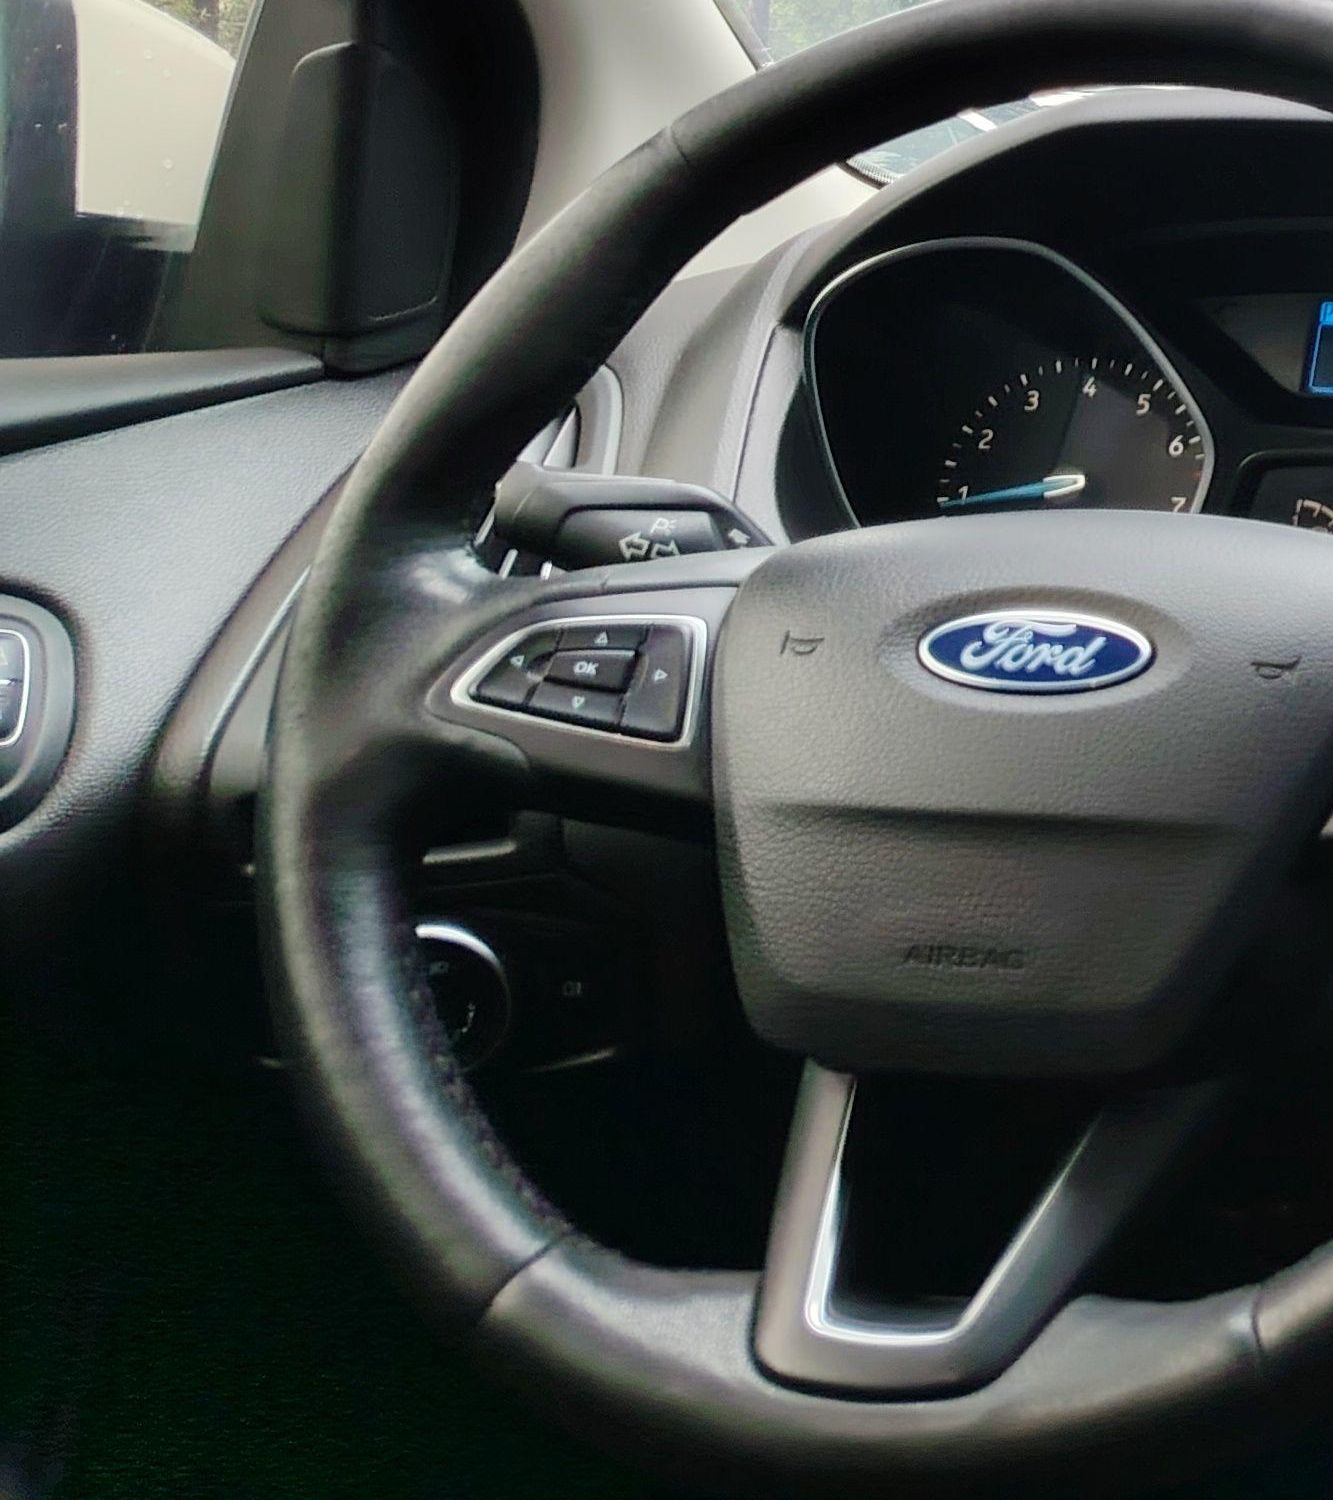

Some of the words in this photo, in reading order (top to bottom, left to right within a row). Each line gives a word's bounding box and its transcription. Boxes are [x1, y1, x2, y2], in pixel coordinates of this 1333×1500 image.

[1082, 376, 1096, 398] 4
[1024, 390, 1040, 411] 3
[1136, 393, 1150, 416] 5
[978, 429, 993, 450] 2
[1168, 435, 1184, 457] 6
[960, 619, 1108, 676] Ford
[573, 659, 598, 675] OK
